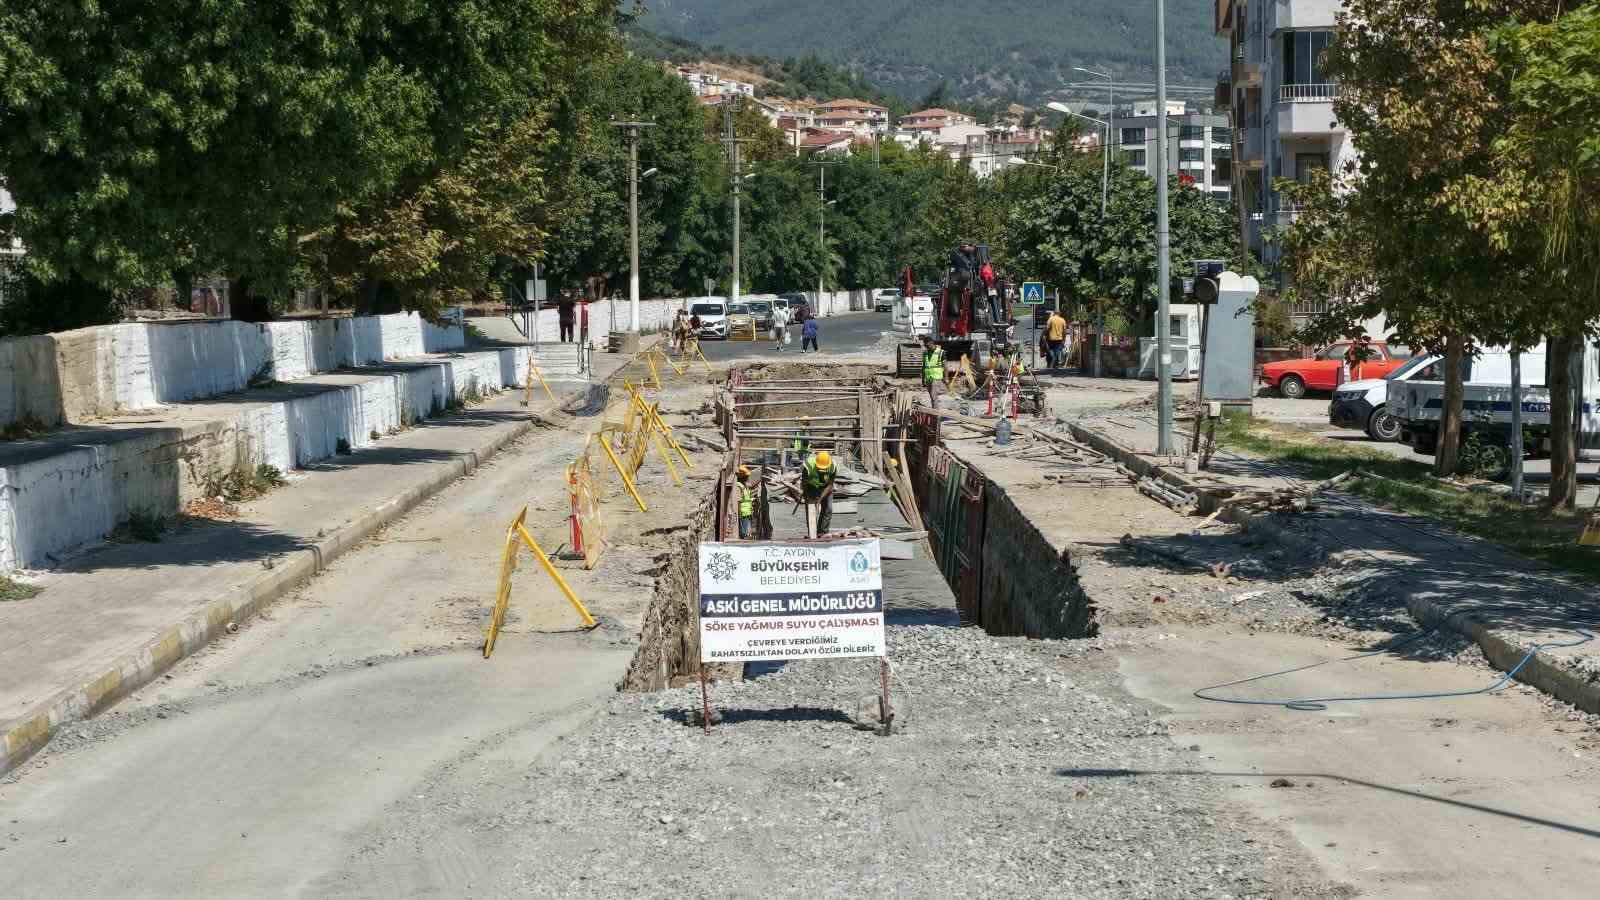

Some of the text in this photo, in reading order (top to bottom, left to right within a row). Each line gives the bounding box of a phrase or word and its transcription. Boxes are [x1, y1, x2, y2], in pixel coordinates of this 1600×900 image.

[784, 548, 816, 557] AYDIN
[751, 559, 829, 573] BÜYÜKŞEHİR
[706, 592, 875, 613] ASKİ GENEL MÜDÜRLÜĞÜ
[705, 618, 879, 631] SÖKE YAĞMUR SUYU ÇALIŞMASI
[747, 635, 838, 647] ÇEVREYE VERDİĞİMİZ
[711, 645, 875, 657] RAHATSIZLIKTAN DOLAYI ÖZÜR DİLERİZ
